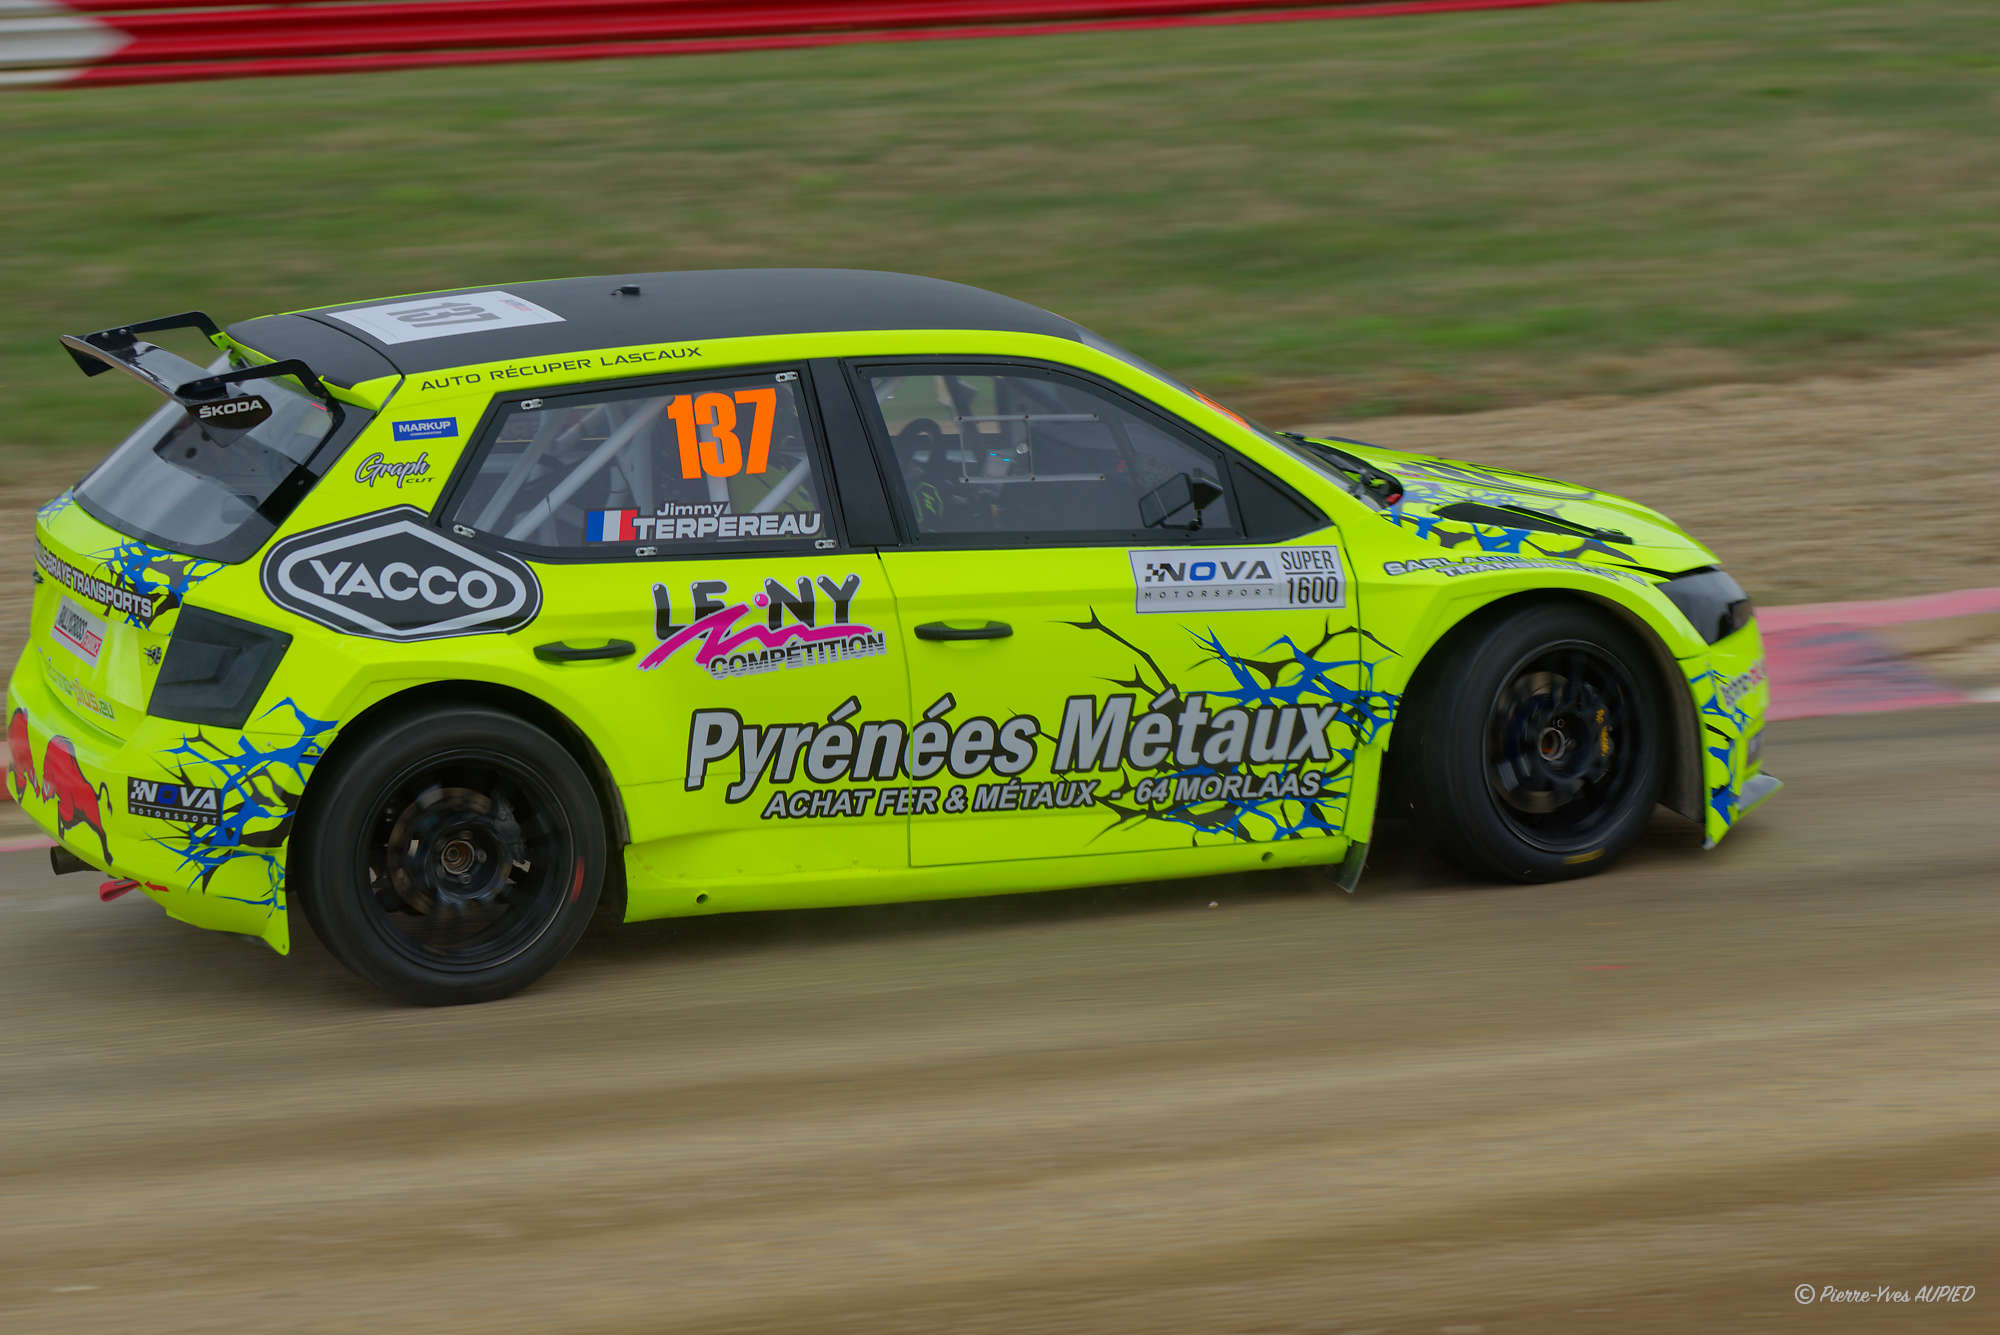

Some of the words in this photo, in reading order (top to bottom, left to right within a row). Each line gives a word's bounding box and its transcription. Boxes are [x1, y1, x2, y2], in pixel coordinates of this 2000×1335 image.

[421, 373, 481, 391] AUTO
[490, 359, 591, 381] RÉCUPER
[600, 347, 702, 367] LASCAUX
[199, 400, 263, 419] ŠKODA
[398, 421, 451, 433] MARKUP
[666, 388, 777, 479] 137
[355, 452, 431, 488] Graph
[657, 503, 724, 517] Jimmy
[633, 513, 821, 540] TERPEREAU
[1156, 561, 1272, 582] NOVA
[1281, 551, 1334, 570] SUPER
[71, 567, 153, 618] TRANSPORTS
[309, 560, 497, 608] YACCO
[1145, 588, 1273, 600] MOTORSPORT
[1287, 576, 1338, 604] 1600
[710, 632, 886, 680] COMPÉTITION
[684, 693, 1041, 804] Pyrénées
[1050, 685, 1342, 774] Métaux
[136, 781, 217, 809] NOVA
[761, 788, 874, 819] ACHAT
[876, 786, 939, 816] FER
[943, 785, 968, 812] &
[972, 777, 1099, 809] MÉTAUX
[1134, 778, 1169, 803] 64
[1174, 772, 1322, 802] MORLAAS
[130, 807, 216, 824] MOTORSPORT
